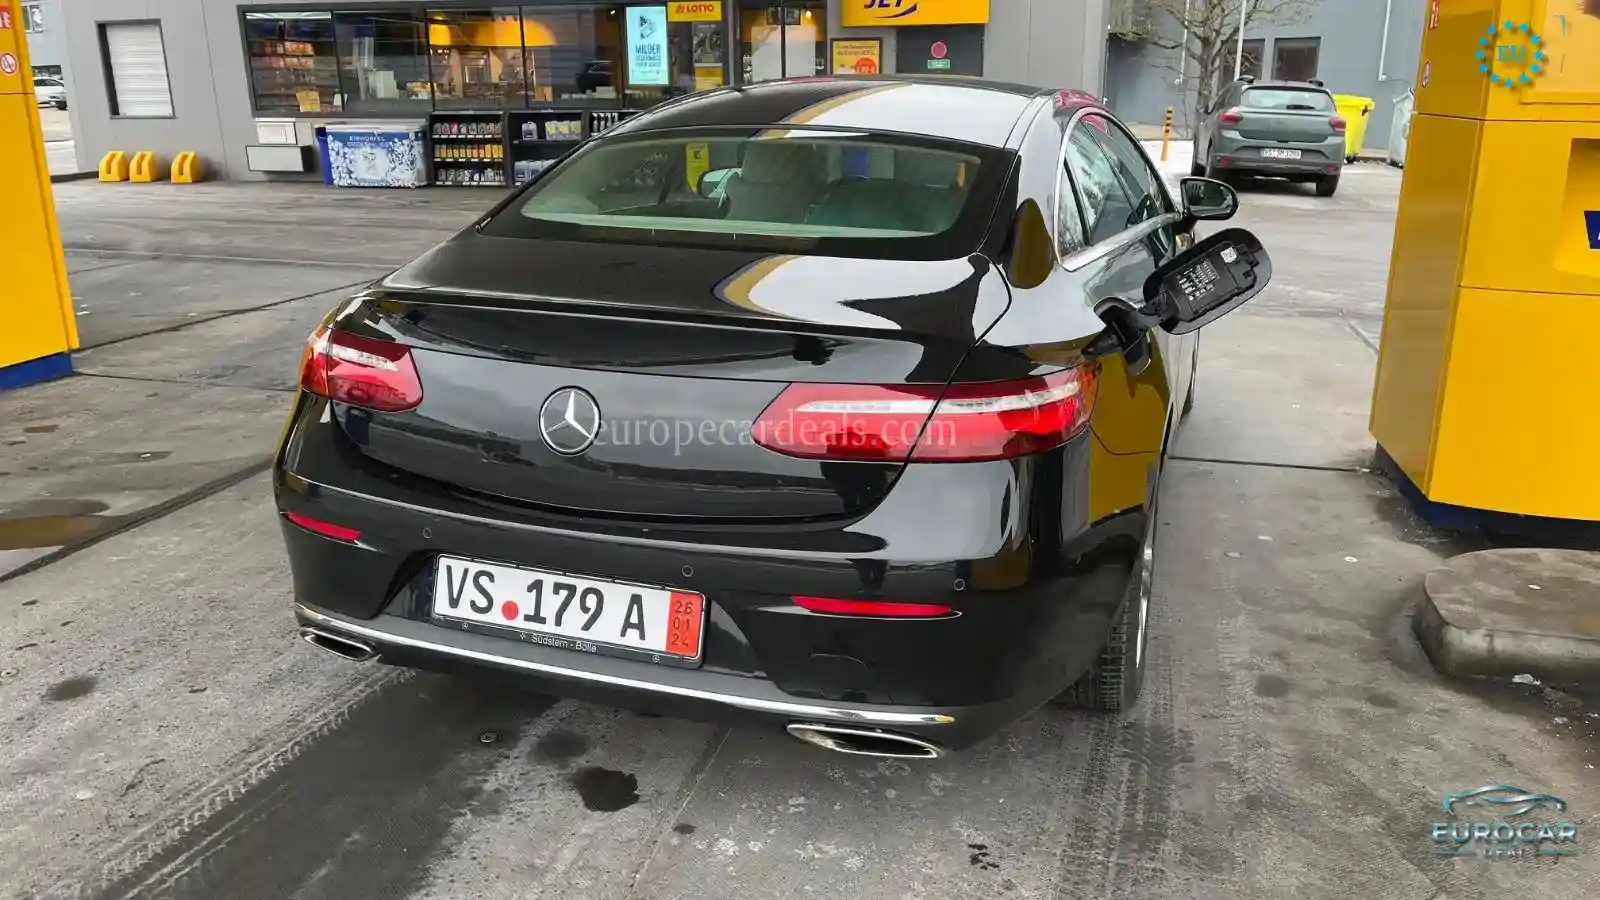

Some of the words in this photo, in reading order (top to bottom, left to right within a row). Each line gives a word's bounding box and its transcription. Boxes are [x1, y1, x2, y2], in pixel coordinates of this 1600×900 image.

[686, 4, 715, 13] LOTTO
[446, 564, 495, 614] VS
[523, 578, 605, 632] 179
[620, 593, 646, 641] A
[675, 600, 693, 614] 26
[673, 616, 690, 630] 01
[671, 633, 689, 647] 24
